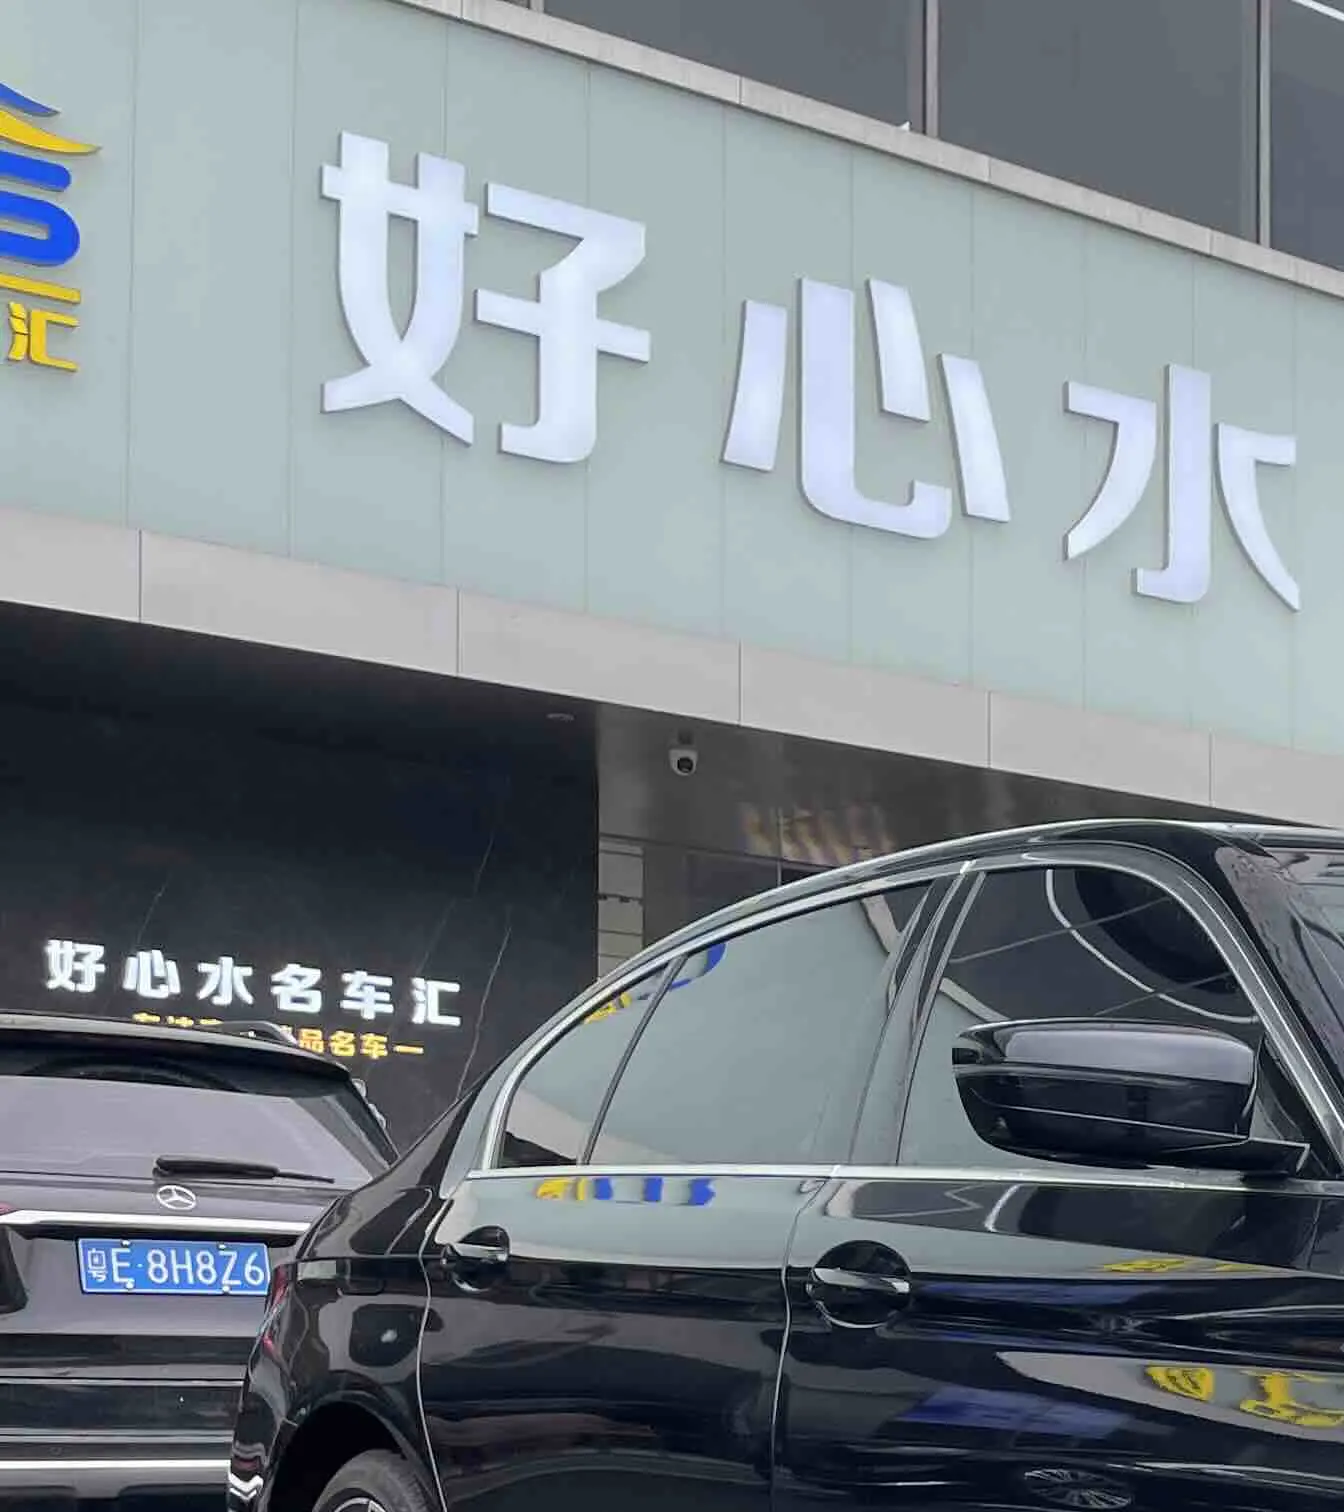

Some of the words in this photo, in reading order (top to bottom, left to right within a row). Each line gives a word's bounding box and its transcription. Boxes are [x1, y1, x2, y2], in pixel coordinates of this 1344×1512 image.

[45, 938, 463, 1027] 好心水名车汇
